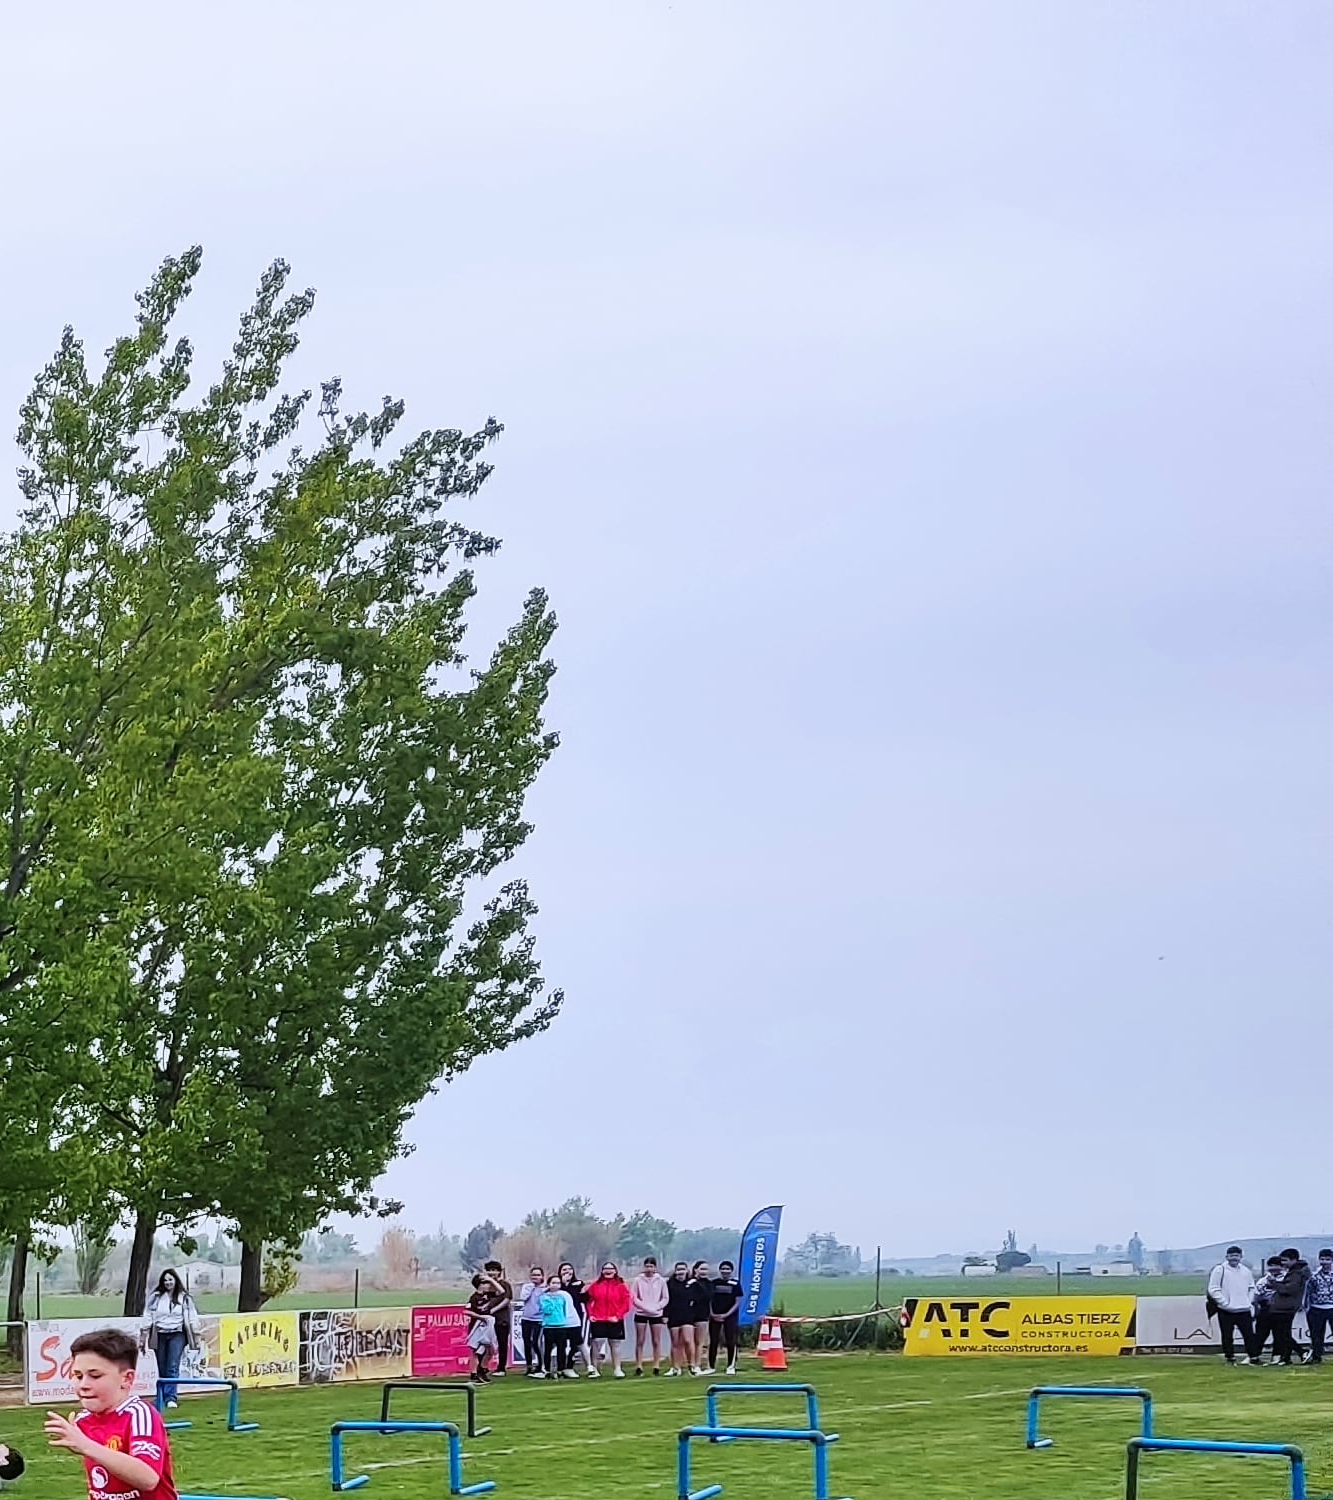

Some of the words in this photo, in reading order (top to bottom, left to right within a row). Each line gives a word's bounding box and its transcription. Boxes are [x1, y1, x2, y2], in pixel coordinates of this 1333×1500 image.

[751, 1237, 765, 1292] Monegros
[921, 1301, 1011, 1338] ATC
[1021, 1313, 1074, 1325] ALBAS
[1077, 1313, 1121, 1325] TIERZ
[1021, 1330, 1120, 1338] CONSTRUCTORA
[948, 1344, 1089, 1354] www.atcconstructora.es
